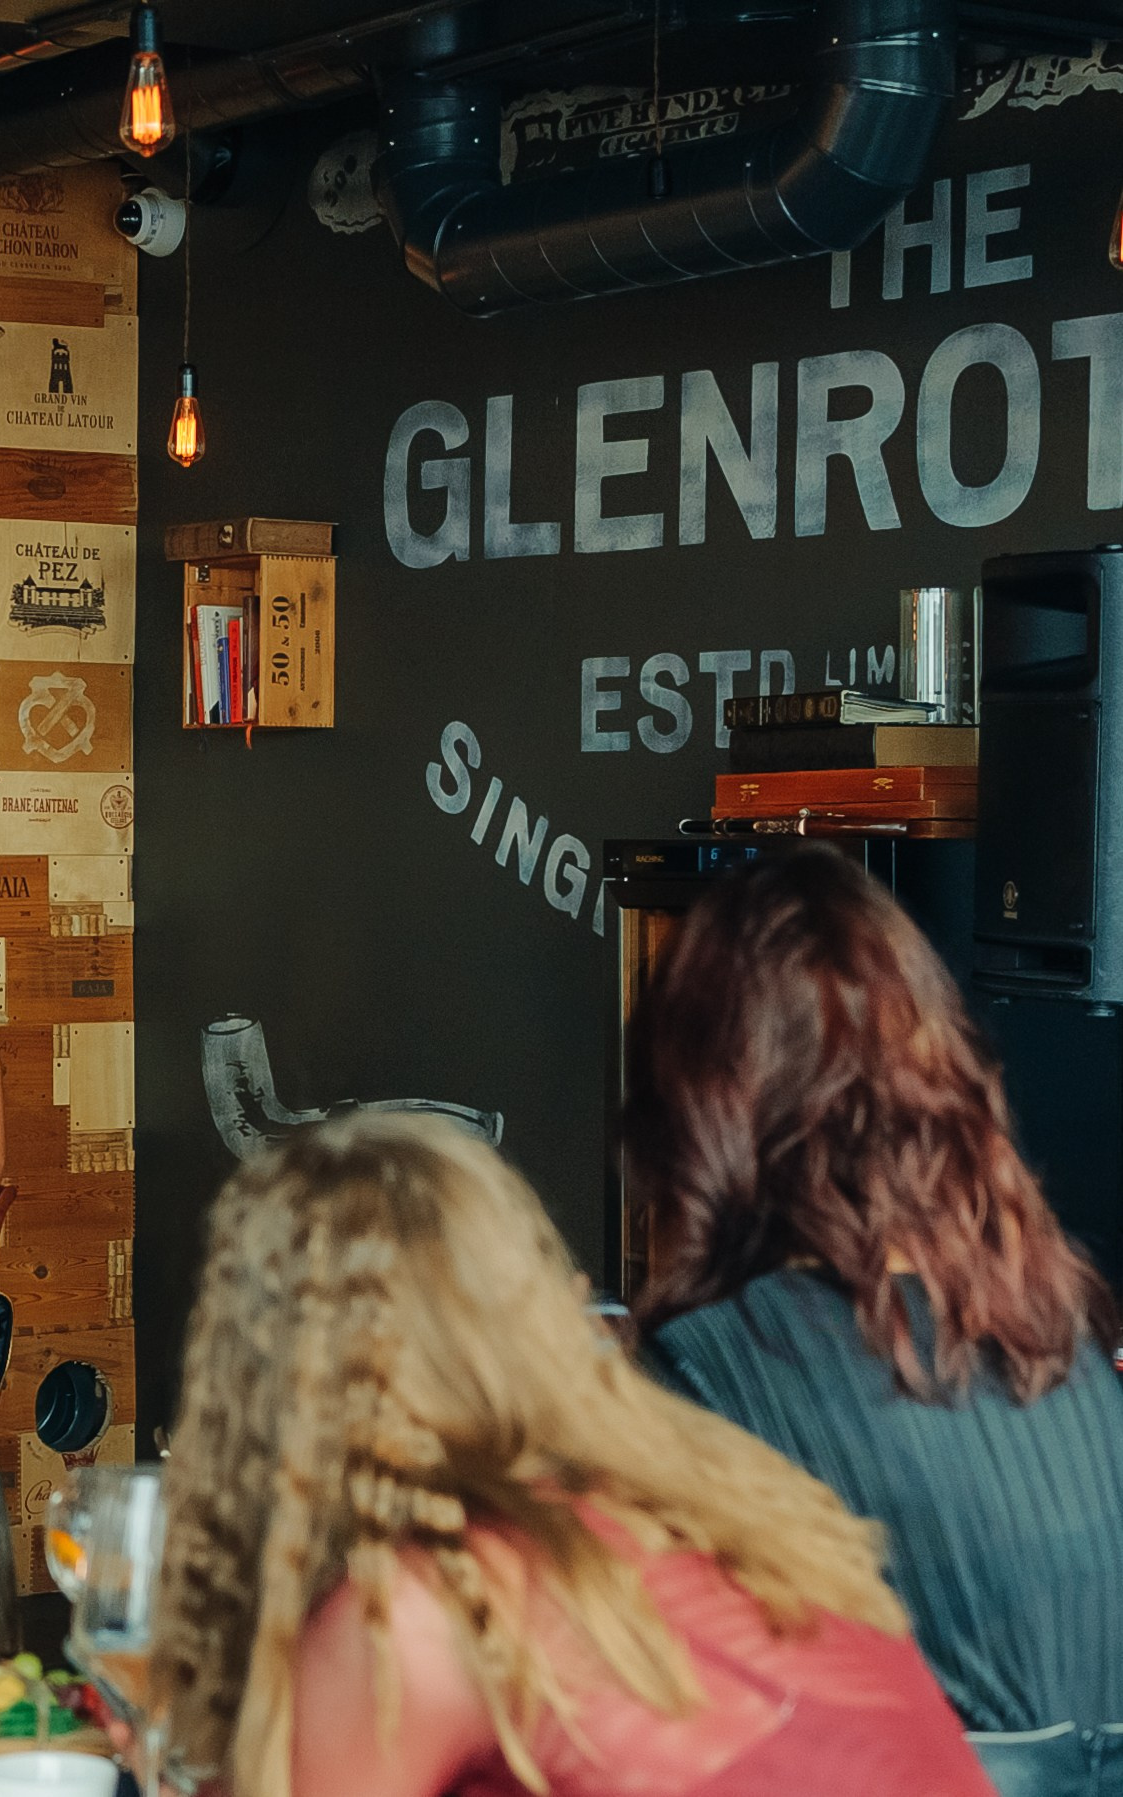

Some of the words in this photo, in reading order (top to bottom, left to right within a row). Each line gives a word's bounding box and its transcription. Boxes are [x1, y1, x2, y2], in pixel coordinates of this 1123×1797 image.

[1, 220, 60, 240] CHÂTEAU
[34, 241, 79, 260] BARON
[33, 392, 68, 405] GRAND
[70, 394, 88, 406] VIN
[6, 410, 64, 428] CHATEAU
[67, 413, 114, 430] LATOUR
[382, 312, 1123, 570] GLENROT
[15, 541, 79, 561] CHÂTEAU
[82, 547, 101, 561] DE
[38, 560, 80, 583] PEZ
[271, 595, 290, 630] 50
[280, 636, 290, 647] &
[271, 652, 290, 687] 50
